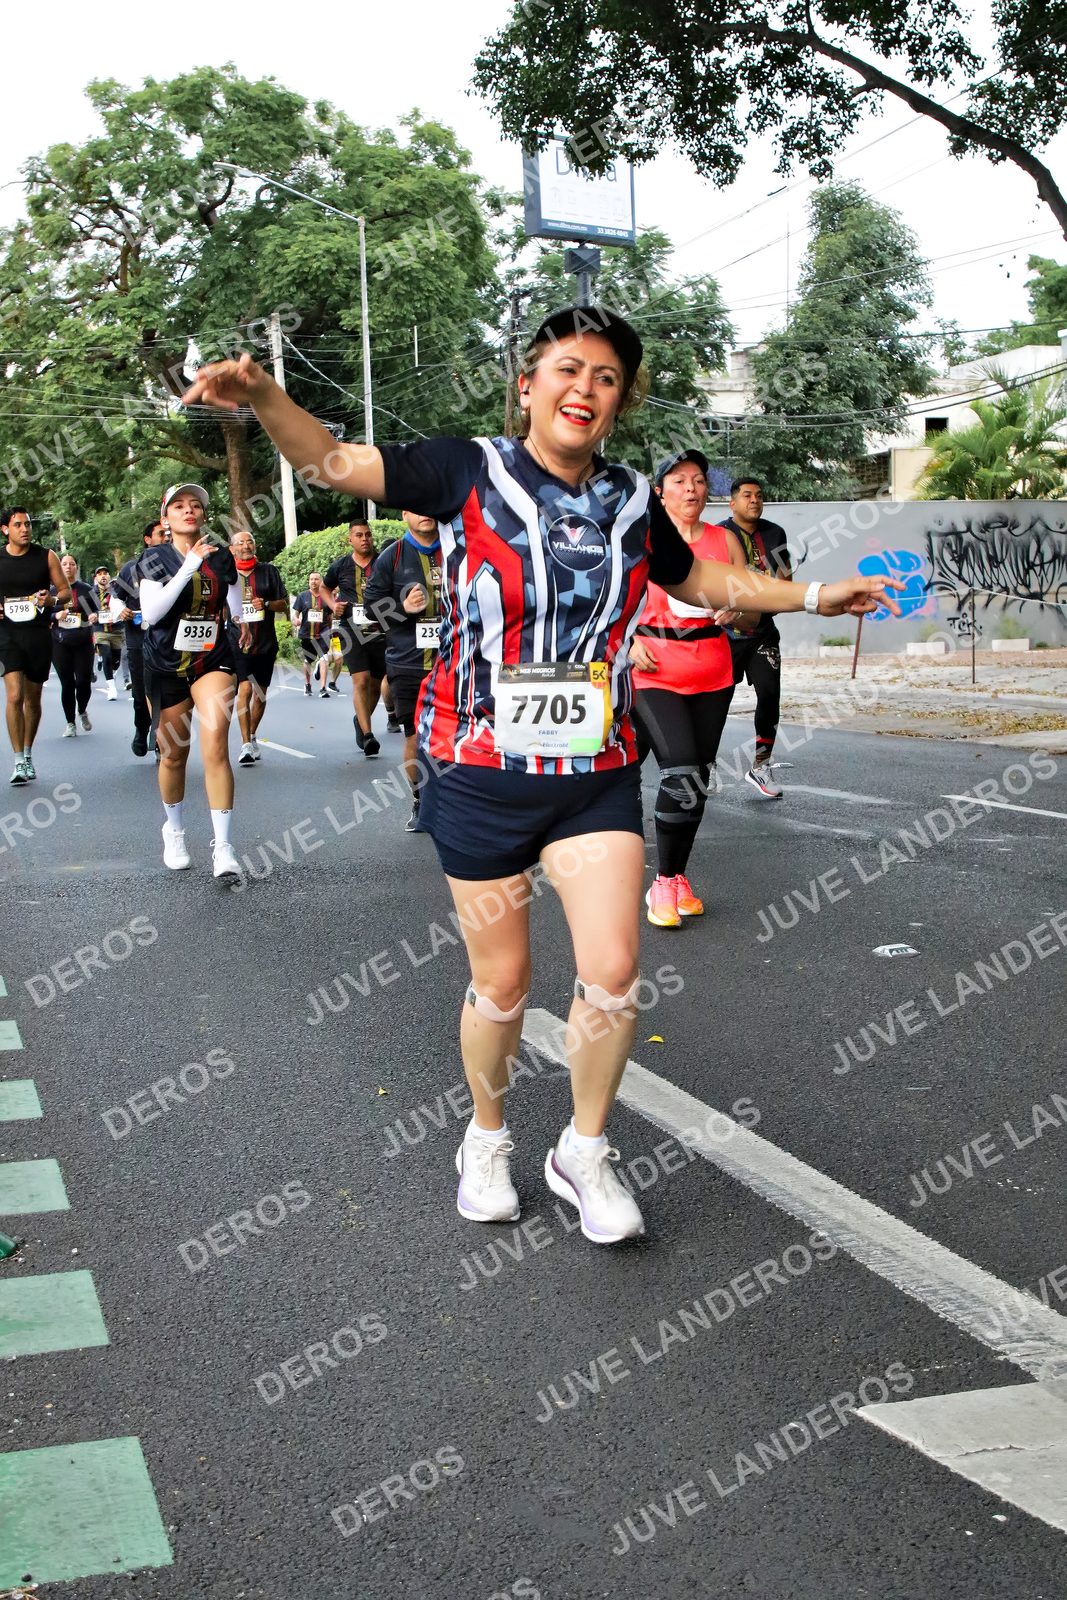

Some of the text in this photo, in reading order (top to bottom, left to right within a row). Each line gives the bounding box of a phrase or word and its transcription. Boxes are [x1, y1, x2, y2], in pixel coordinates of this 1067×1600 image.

[552, 541, 604, 555] VILLANOS
[10, 604, 30, 613] 5798
[184, 626, 212, 639] 9336
[592, 669, 606, 680] 5K
[511, 694, 587, 725] 7705
